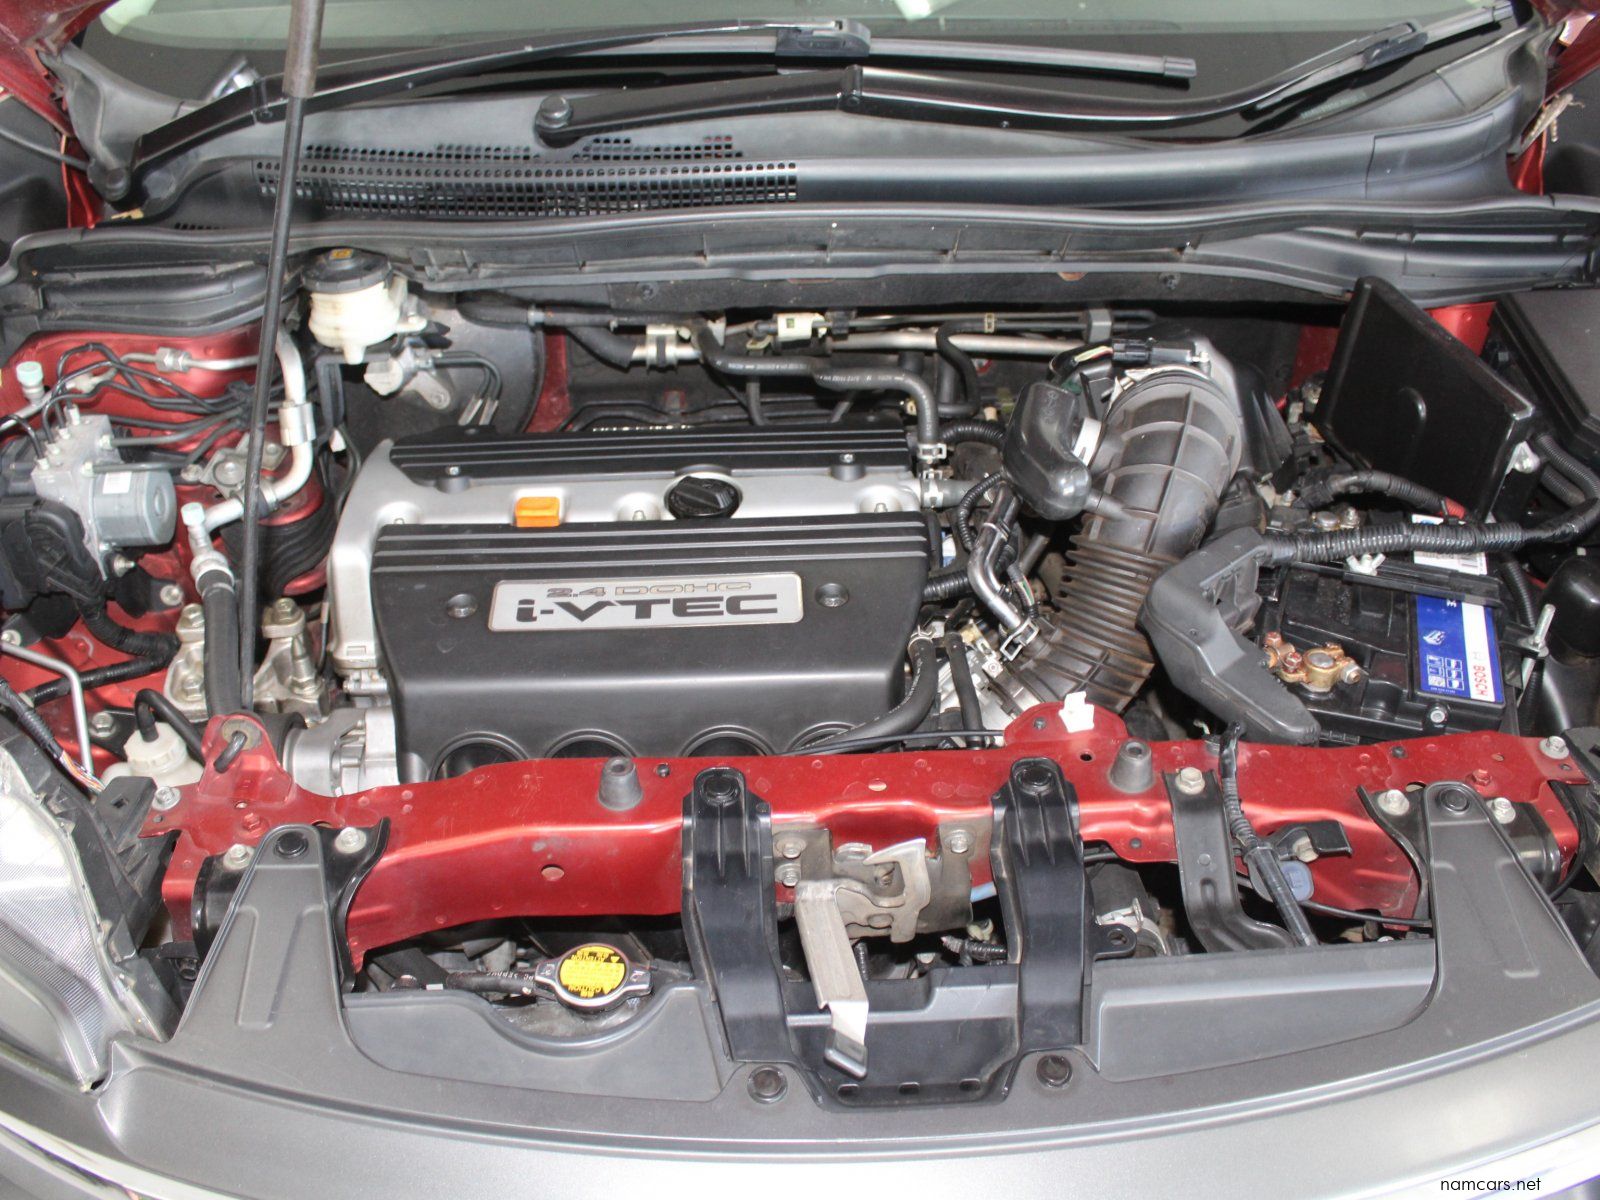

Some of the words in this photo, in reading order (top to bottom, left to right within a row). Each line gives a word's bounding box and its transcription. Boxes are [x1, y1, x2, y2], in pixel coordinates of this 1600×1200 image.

[547, 587, 606, 598] 2.4
[615, 582, 752, 596] DOHC
[516, 594, 778, 623] i-VTEC
[1473, 665, 1488, 696] BOSCH
